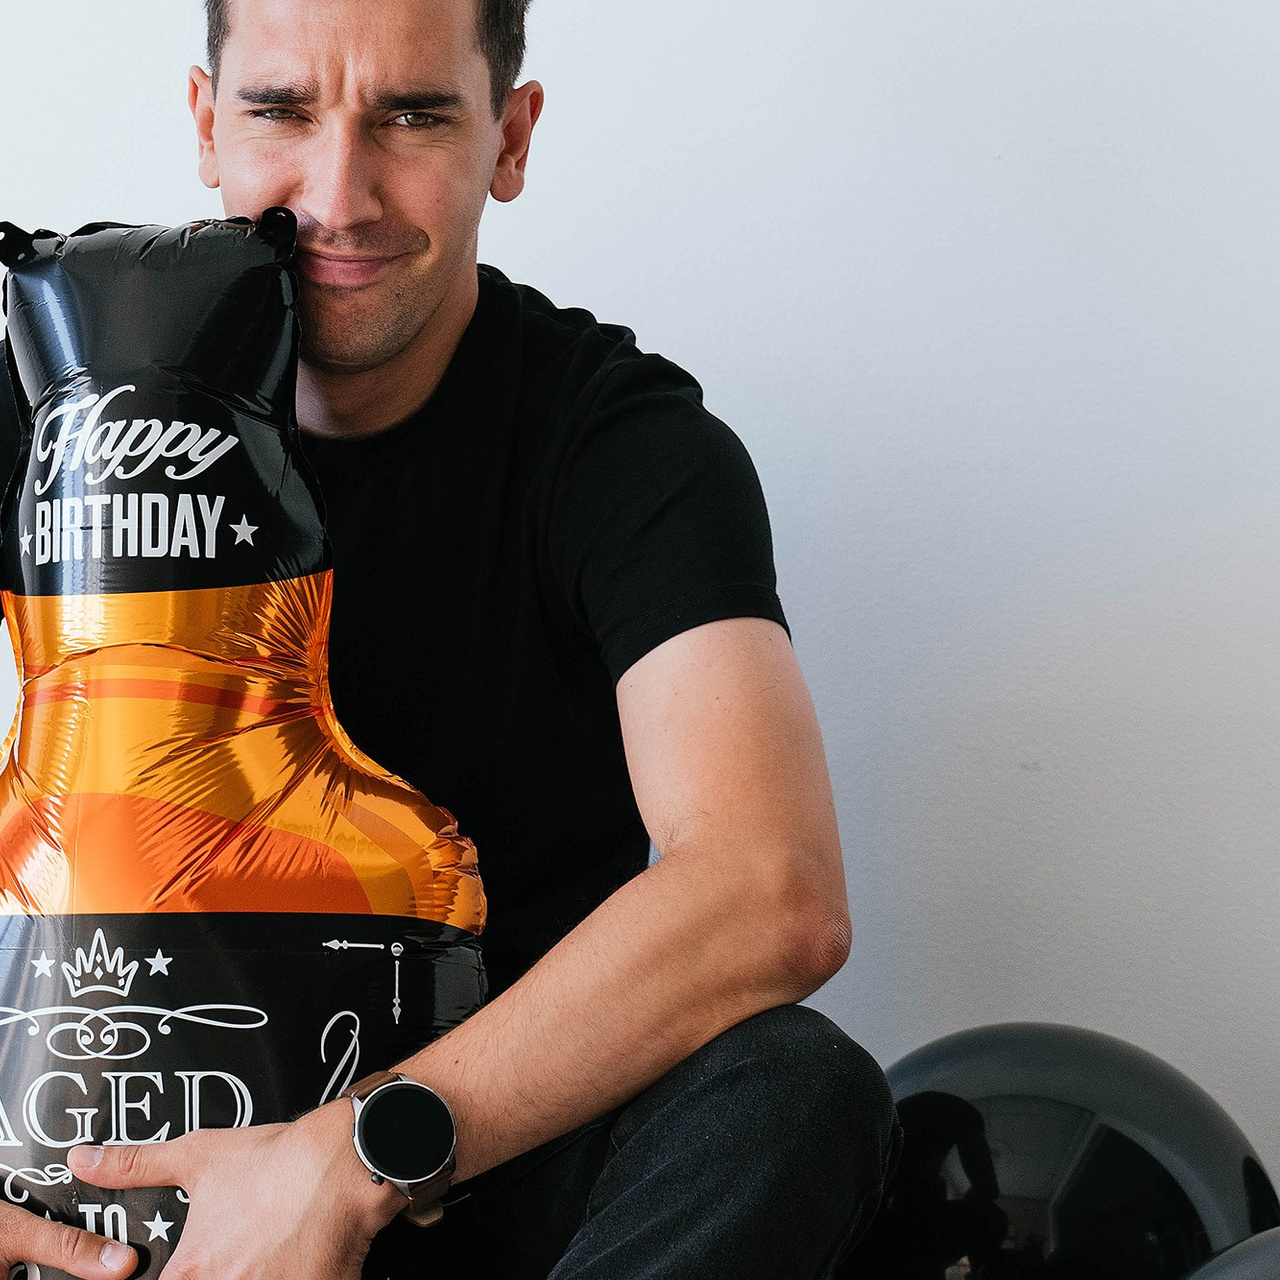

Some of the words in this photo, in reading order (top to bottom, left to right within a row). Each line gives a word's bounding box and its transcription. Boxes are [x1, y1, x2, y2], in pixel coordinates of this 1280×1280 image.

[34, 384, 239, 496] Happy
[35, 493, 226, 566] BIRTHDAY
[78, 1203, 128, 1245] TO
